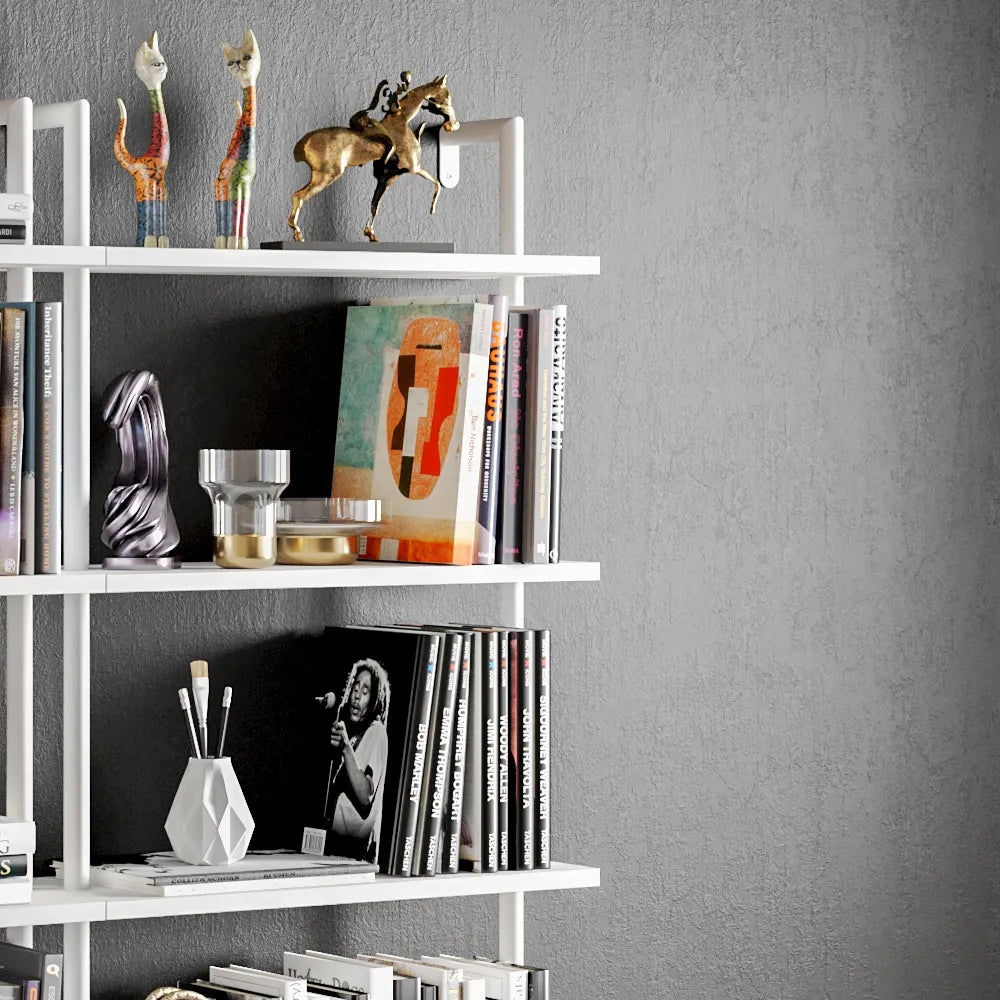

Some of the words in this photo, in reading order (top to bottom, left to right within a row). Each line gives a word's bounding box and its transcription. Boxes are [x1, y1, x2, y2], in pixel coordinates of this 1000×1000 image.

[43, 306, 52, 365] Inheritance
[513, 328, 523, 357] Ron
[487, 320, 506, 422] BAUHAUS
[511, 363, 522, 398] Arad
[467, 435, 476, 472] Nicholson
[416, 724, 426, 750] BOB
[440, 707, 451, 746] EMMA
[487, 719, 496, 744] JIMI
[500, 715, 508, 761] WOODY
[522, 708, 532, 745] JOHN
[410, 750, 425, 802] MARLEY
[431, 748, 449, 818] THOMPSON
[487, 746, 496, 802] HENDRIX
[500, 763, 508, 802] ALLEN
[522, 747, 532, 809] TRAVOLTA
[402, 836, 412, 871] TASCHEN
[427, 836, 437, 871] TASCHEN
